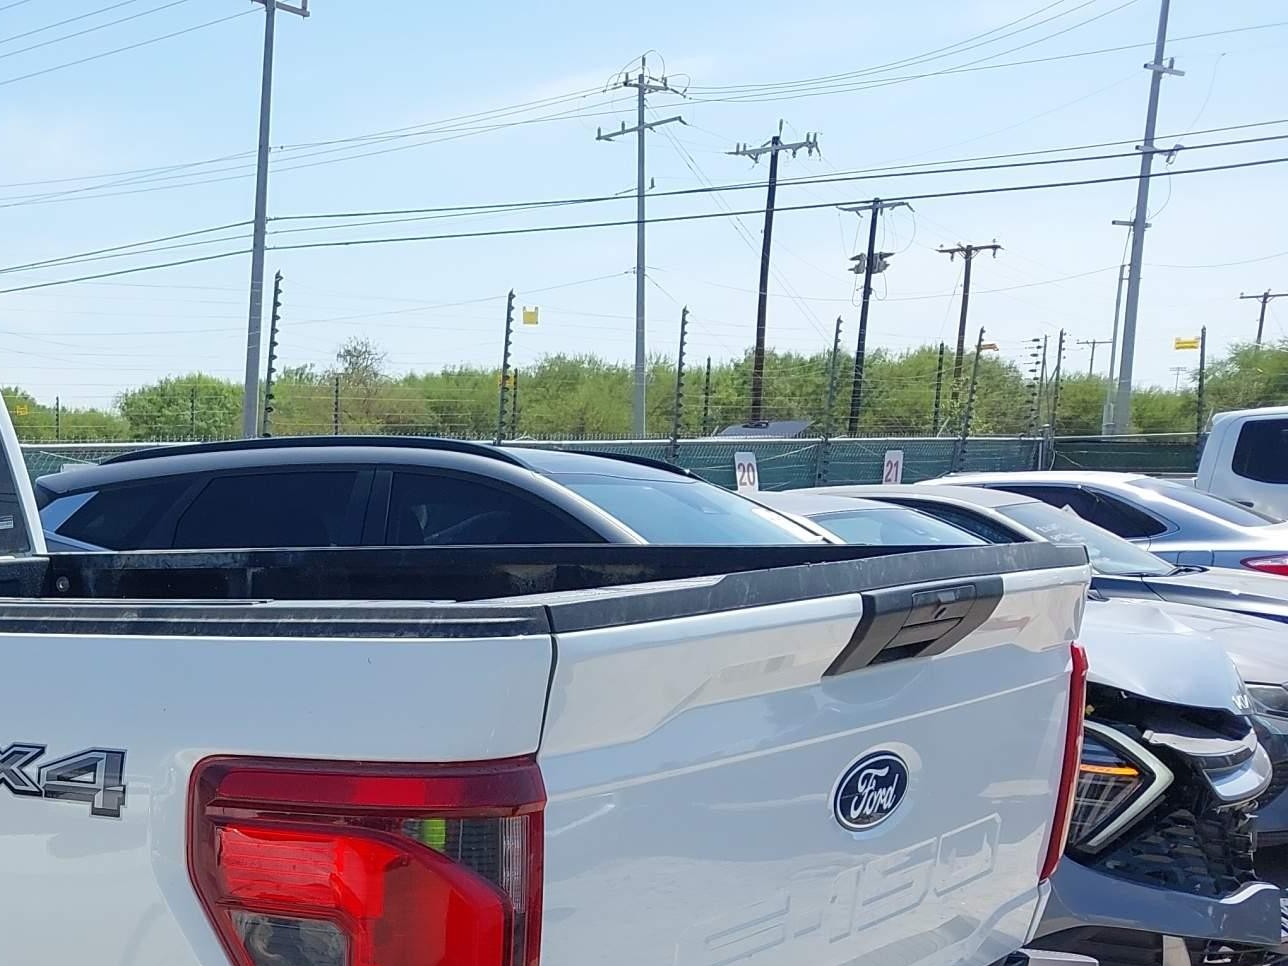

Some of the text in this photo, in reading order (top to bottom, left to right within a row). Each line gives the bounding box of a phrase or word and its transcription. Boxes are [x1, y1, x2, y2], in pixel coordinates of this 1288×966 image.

[737, 462, 756, 487] 20
[884, 460, 900, 483] 21
[850, 765, 899, 819] Ford
